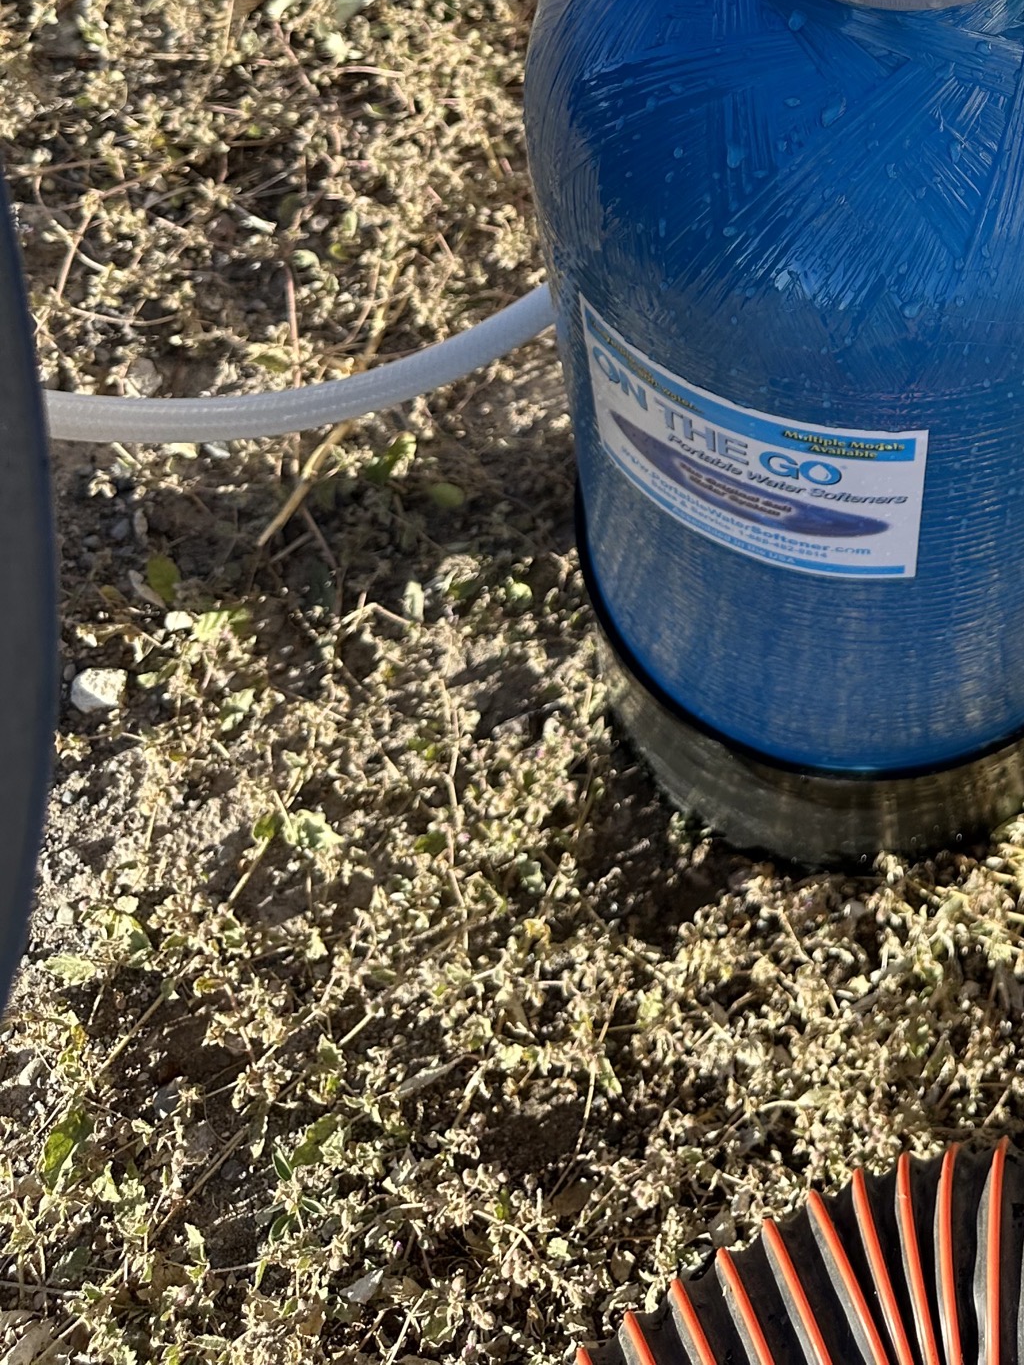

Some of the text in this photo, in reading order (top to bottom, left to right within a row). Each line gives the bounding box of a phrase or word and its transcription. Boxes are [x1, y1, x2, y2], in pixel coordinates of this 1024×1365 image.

[592, 346, 648, 411] ON
[654, 396, 749, 467] THE
[758, 450, 842, 485] GO
[783, 430, 905, 452] Multiple Models
[810, 443, 878, 459] Available
[668, 434, 909, 504] Portable Water Softeners
